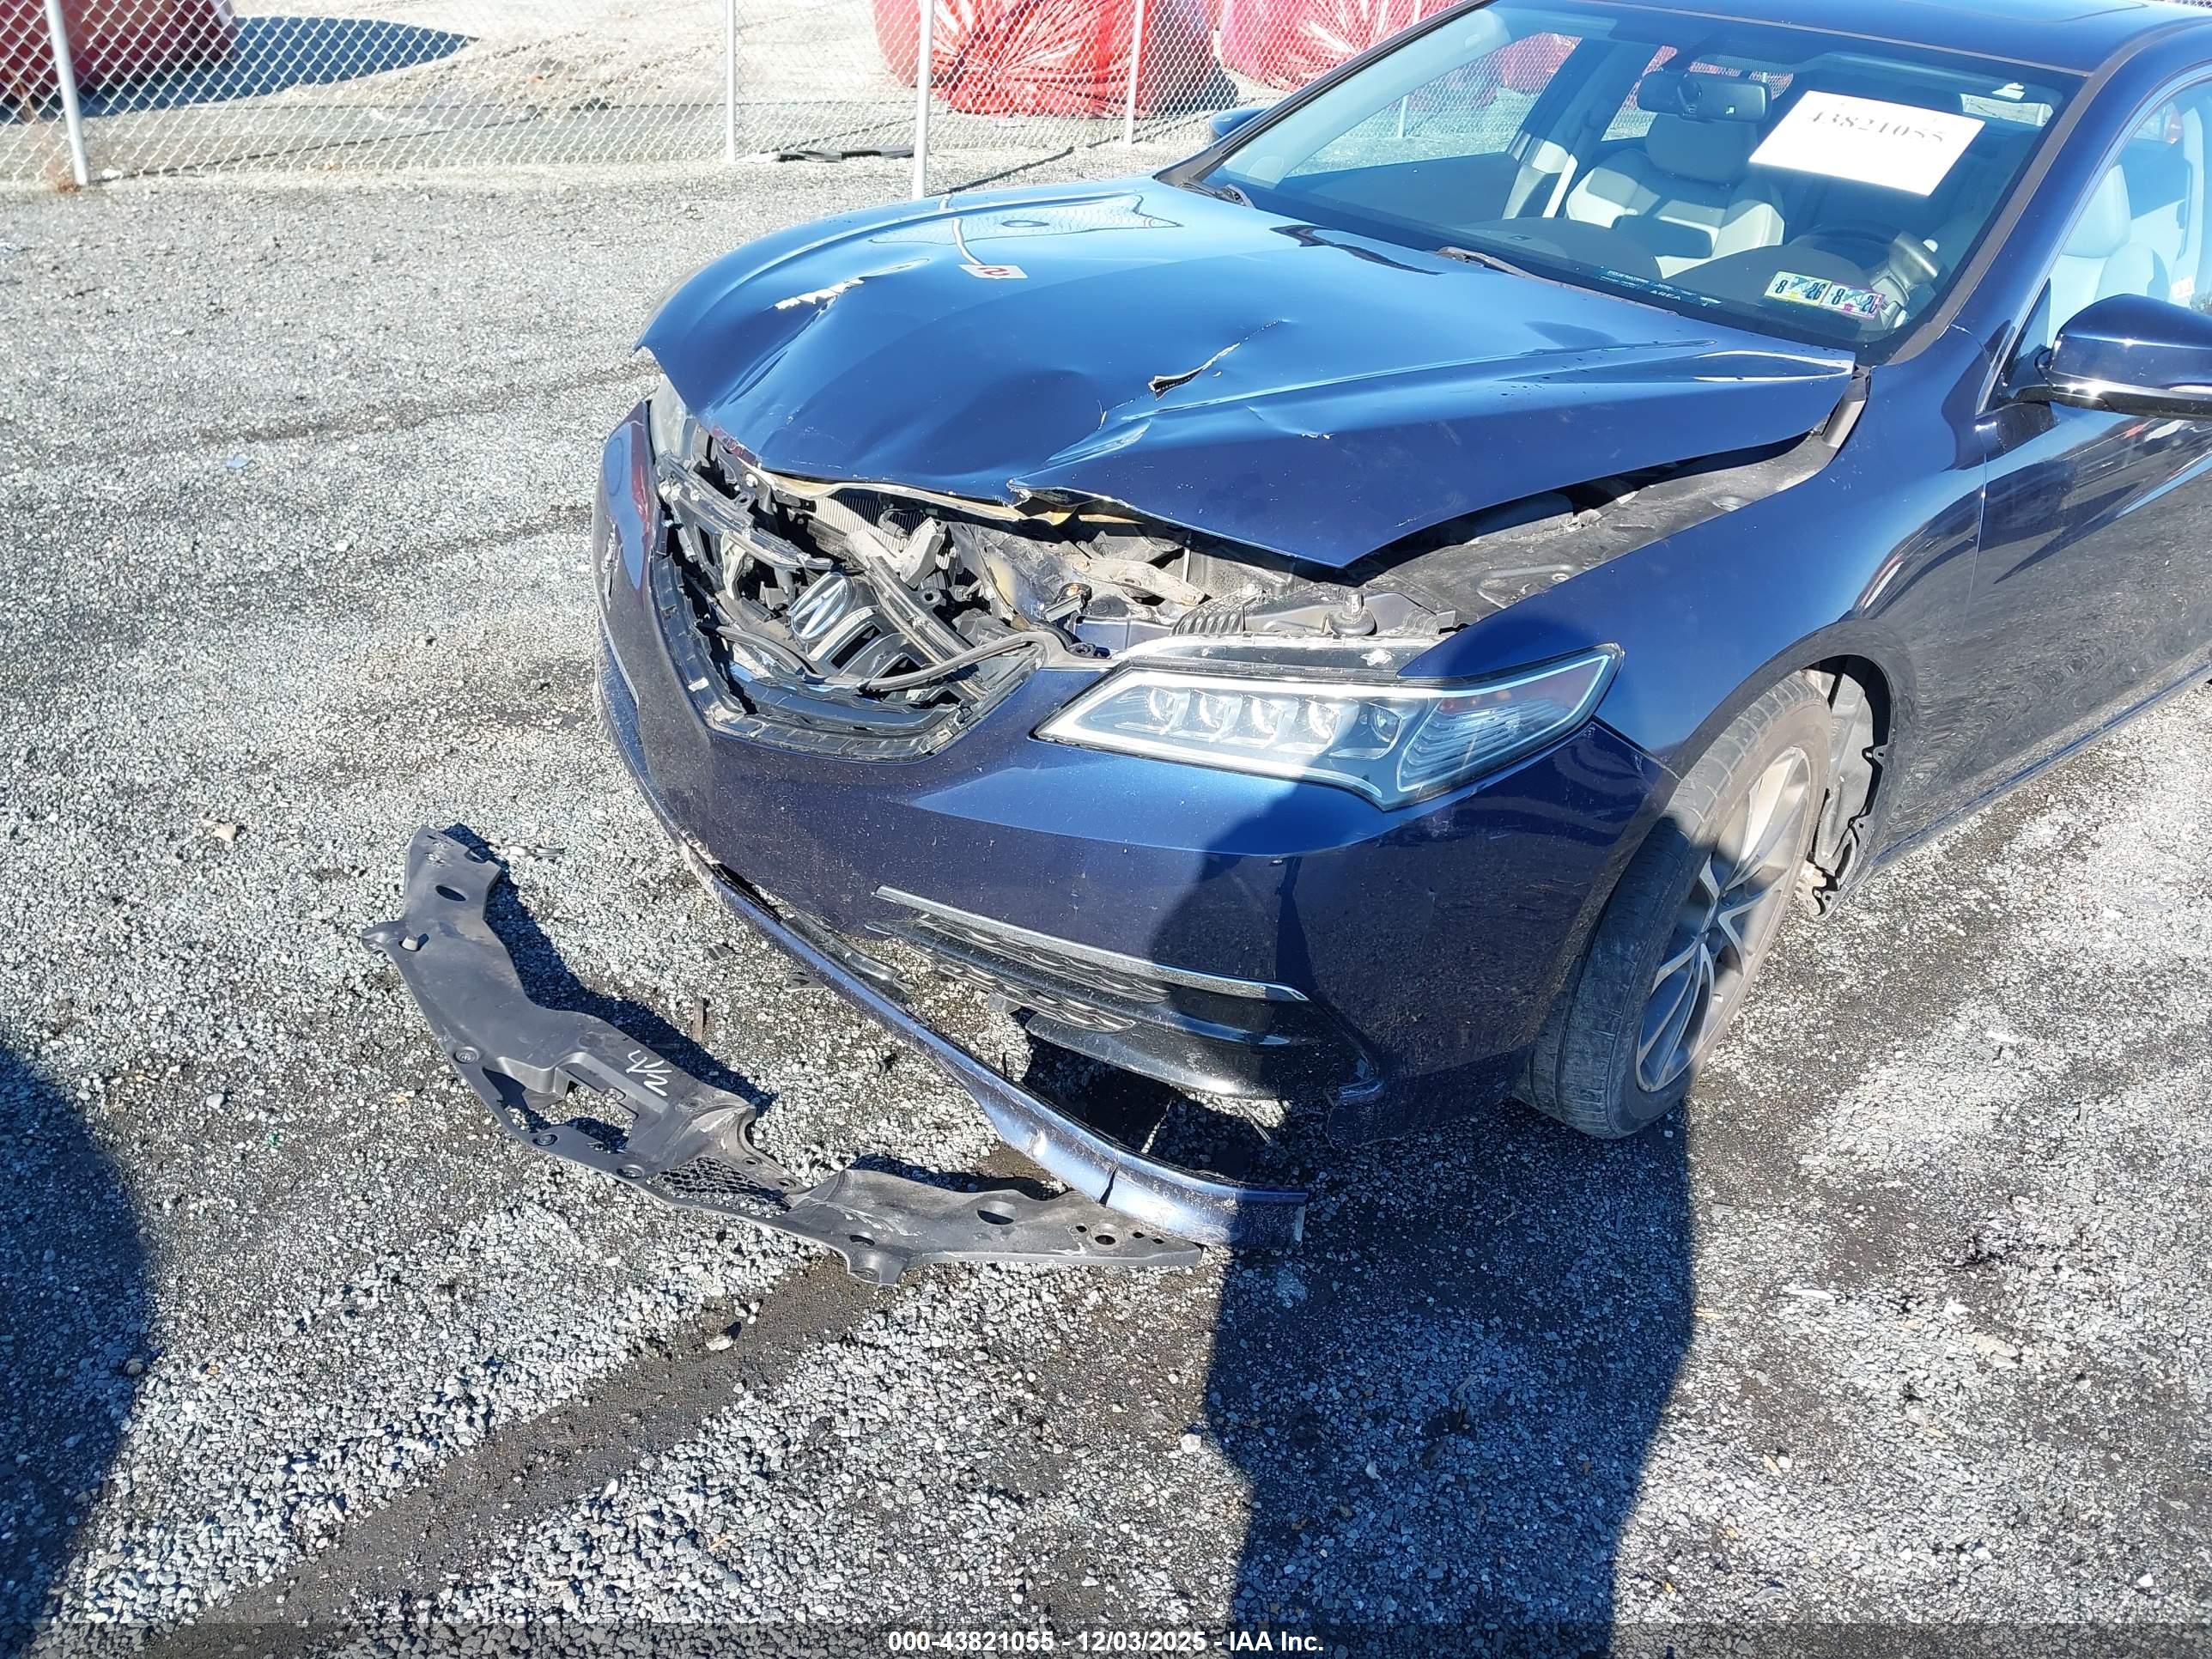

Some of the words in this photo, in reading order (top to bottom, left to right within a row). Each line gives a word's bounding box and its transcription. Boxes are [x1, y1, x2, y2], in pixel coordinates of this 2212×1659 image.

[1775, 279, 1789, 294] 8
[1805, 282, 1826, 301] 26
[1831, 288, 1846, 305] 8
